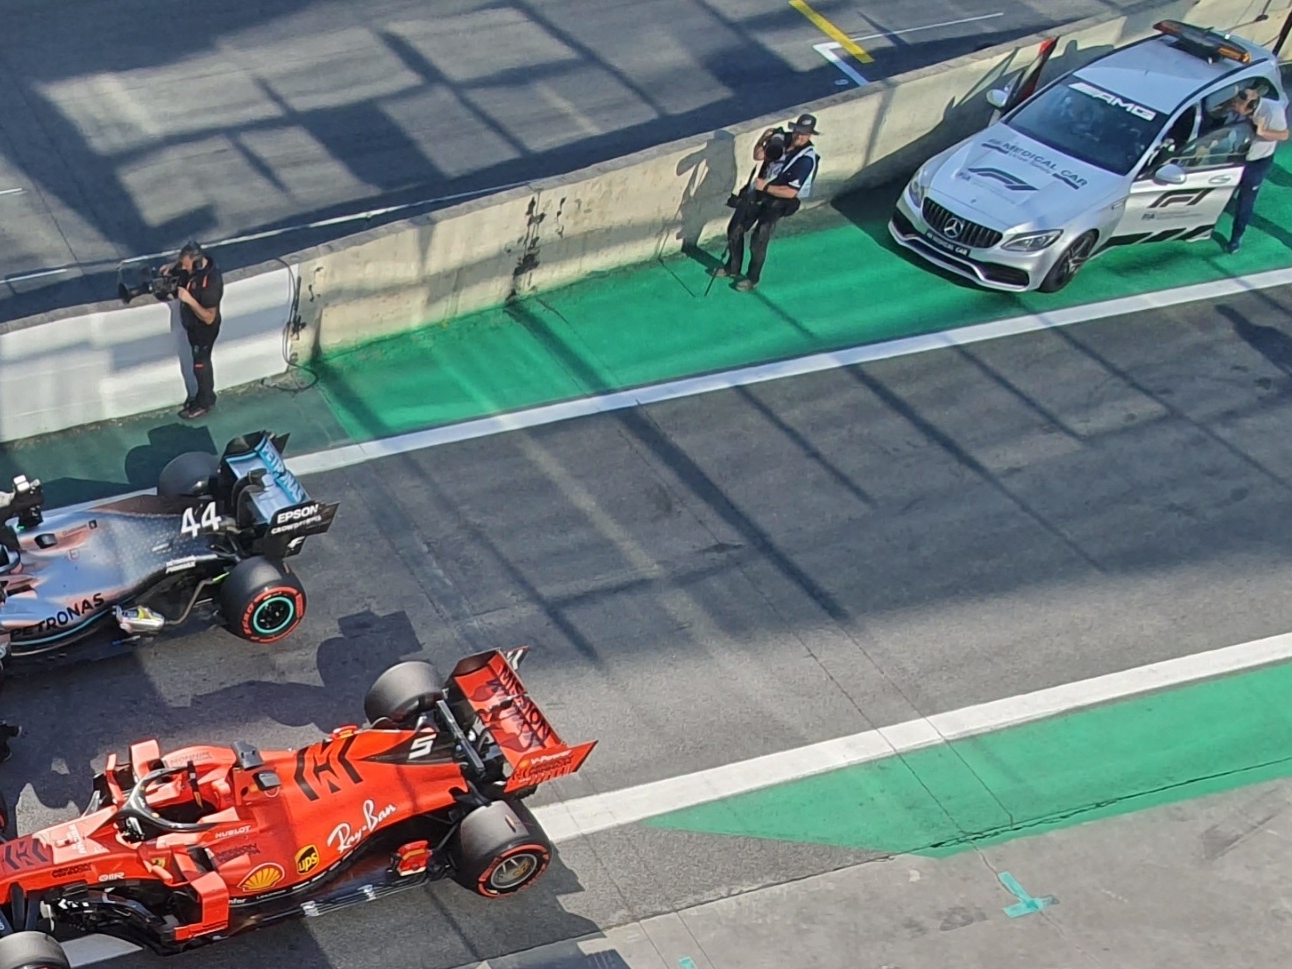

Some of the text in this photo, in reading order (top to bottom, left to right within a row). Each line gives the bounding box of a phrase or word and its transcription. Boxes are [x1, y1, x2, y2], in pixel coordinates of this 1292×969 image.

[1002, 141, 1057, 173] MEDICAL
[1060, 168, 1088, 188] CAR
[180, 501, 222, 538] 44
[276, 503, 319, 525] EPSON
[10, 592, 105, 637] PETRONAS
[408, 733, 437, 761] 5
[298, 853, 318, 873] ups
